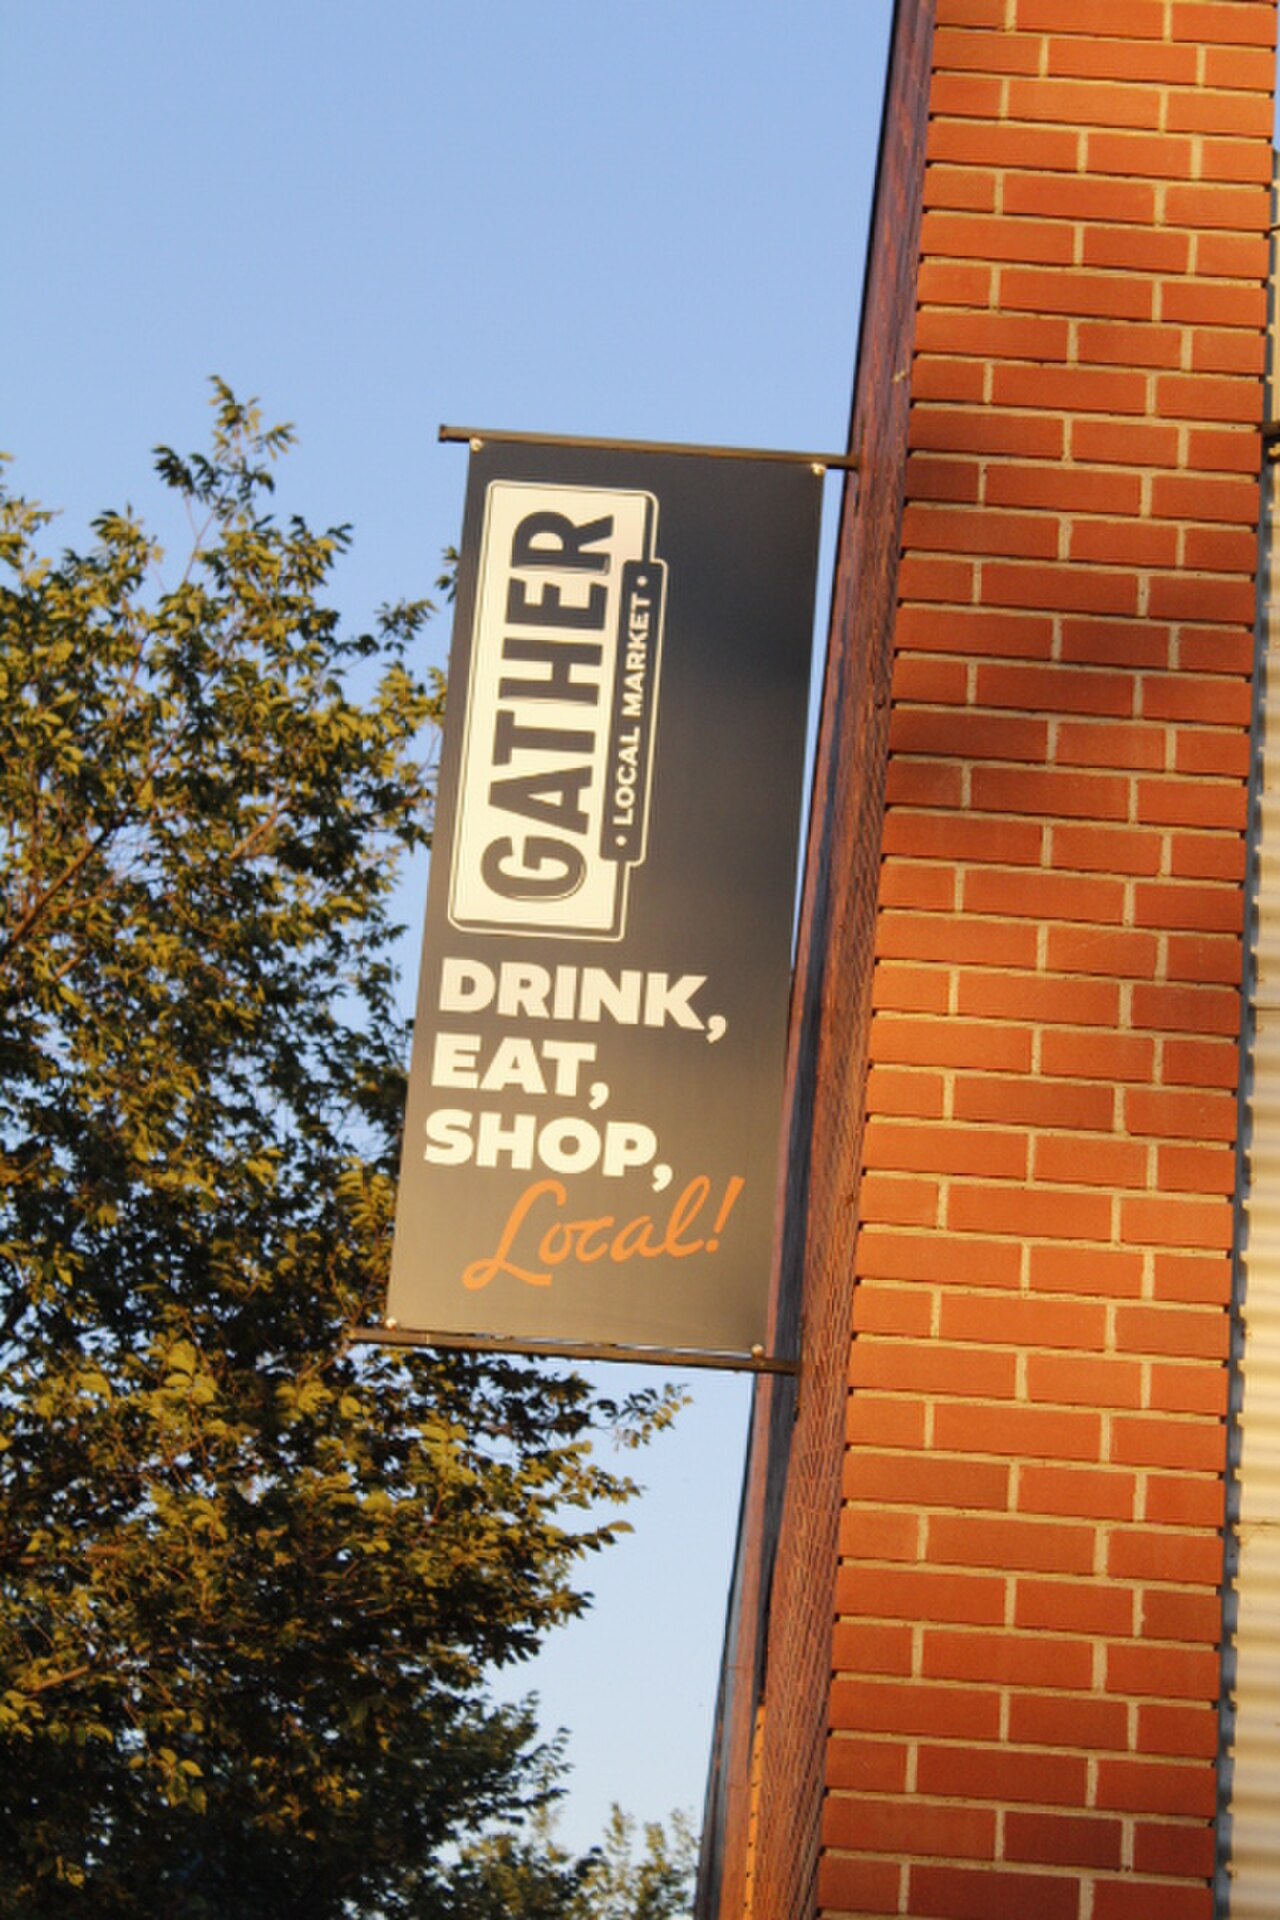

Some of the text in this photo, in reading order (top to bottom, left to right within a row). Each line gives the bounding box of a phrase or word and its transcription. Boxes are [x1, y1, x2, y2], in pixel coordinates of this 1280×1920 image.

[480, 510, 615, 902] GATHER
[613, 593, 652, 826] LOCAL MARKET
[438, 957, 727, 1043] DRINK,
[431, 1032, 609, 1110] EAT,
[424, 1108, 673, 1192] SHOP,
[461, 1175, 745, 1290] Local!
